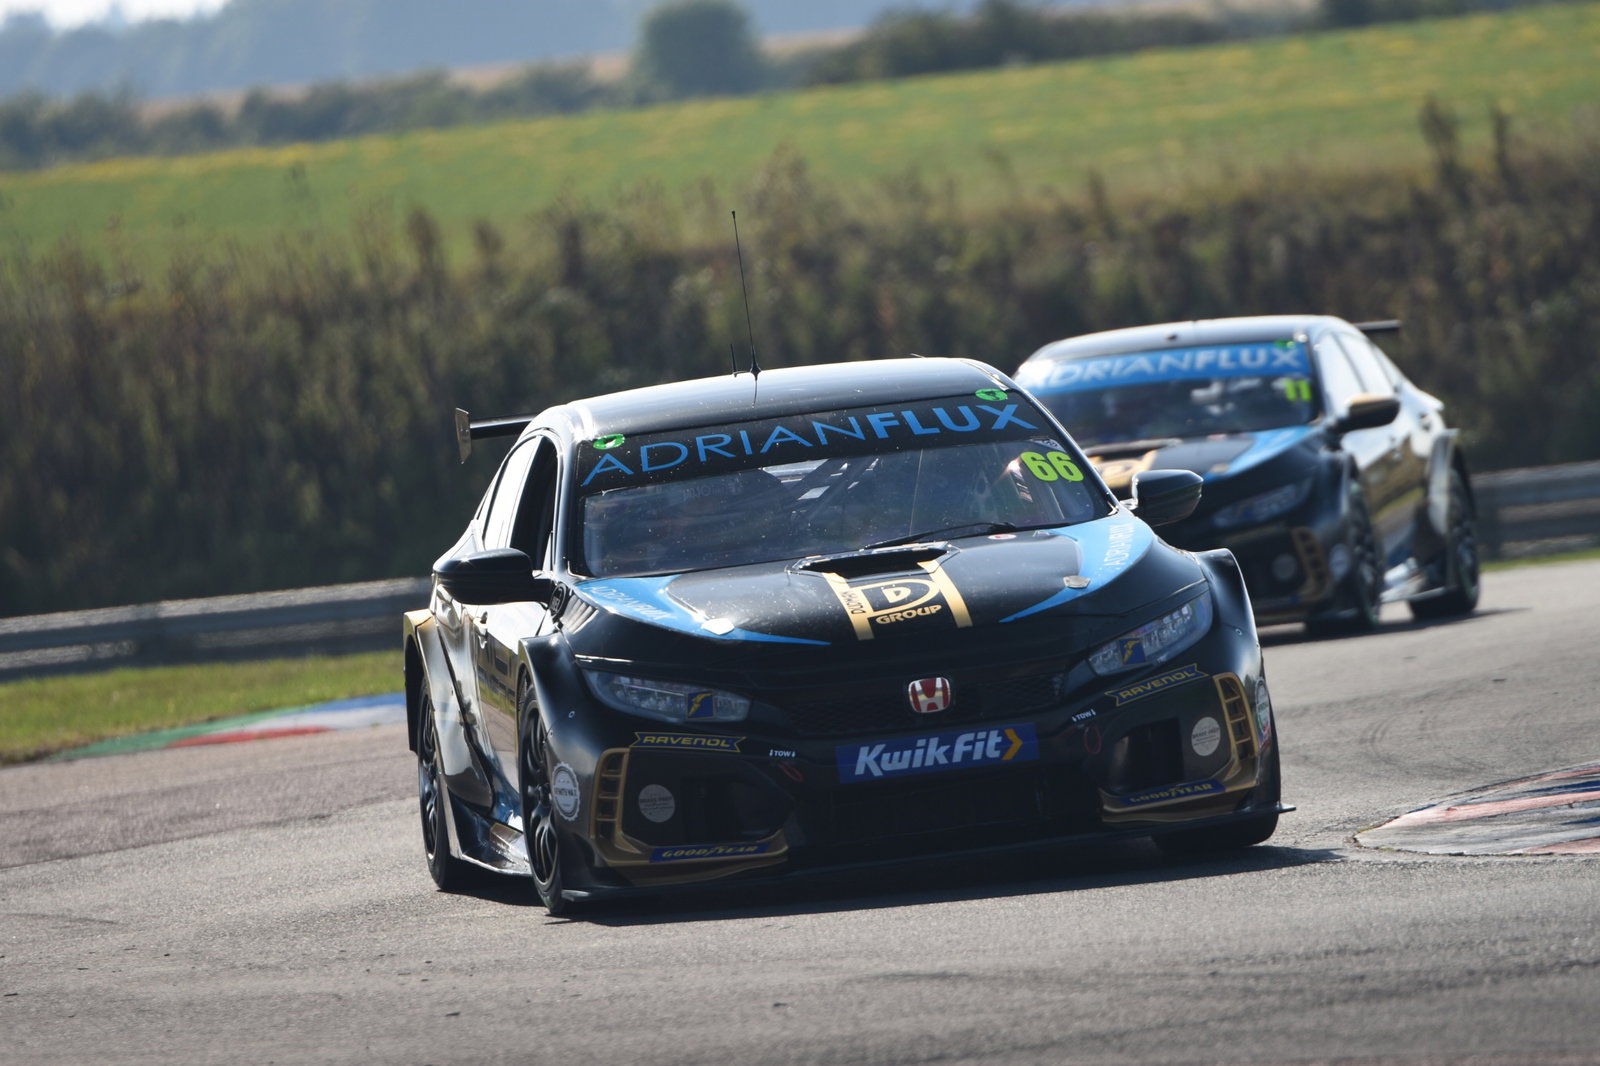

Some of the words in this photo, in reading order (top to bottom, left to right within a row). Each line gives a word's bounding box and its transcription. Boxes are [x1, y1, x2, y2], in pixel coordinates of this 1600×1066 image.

[1022, 348, 1300, 388] DRIANFLUX
[1285, 380, 1311, 402] 11
[581, 404, 1038, 487] ADRIANFLUX
[1021, 451, 1084, 482] 66
[875, 605, 942, 624] GROUP
[1119, 670, 1196, 699] RAVENOL
[643, 736, 730, 748] RAVENOL
[774, 750, 791, 758] TOW
